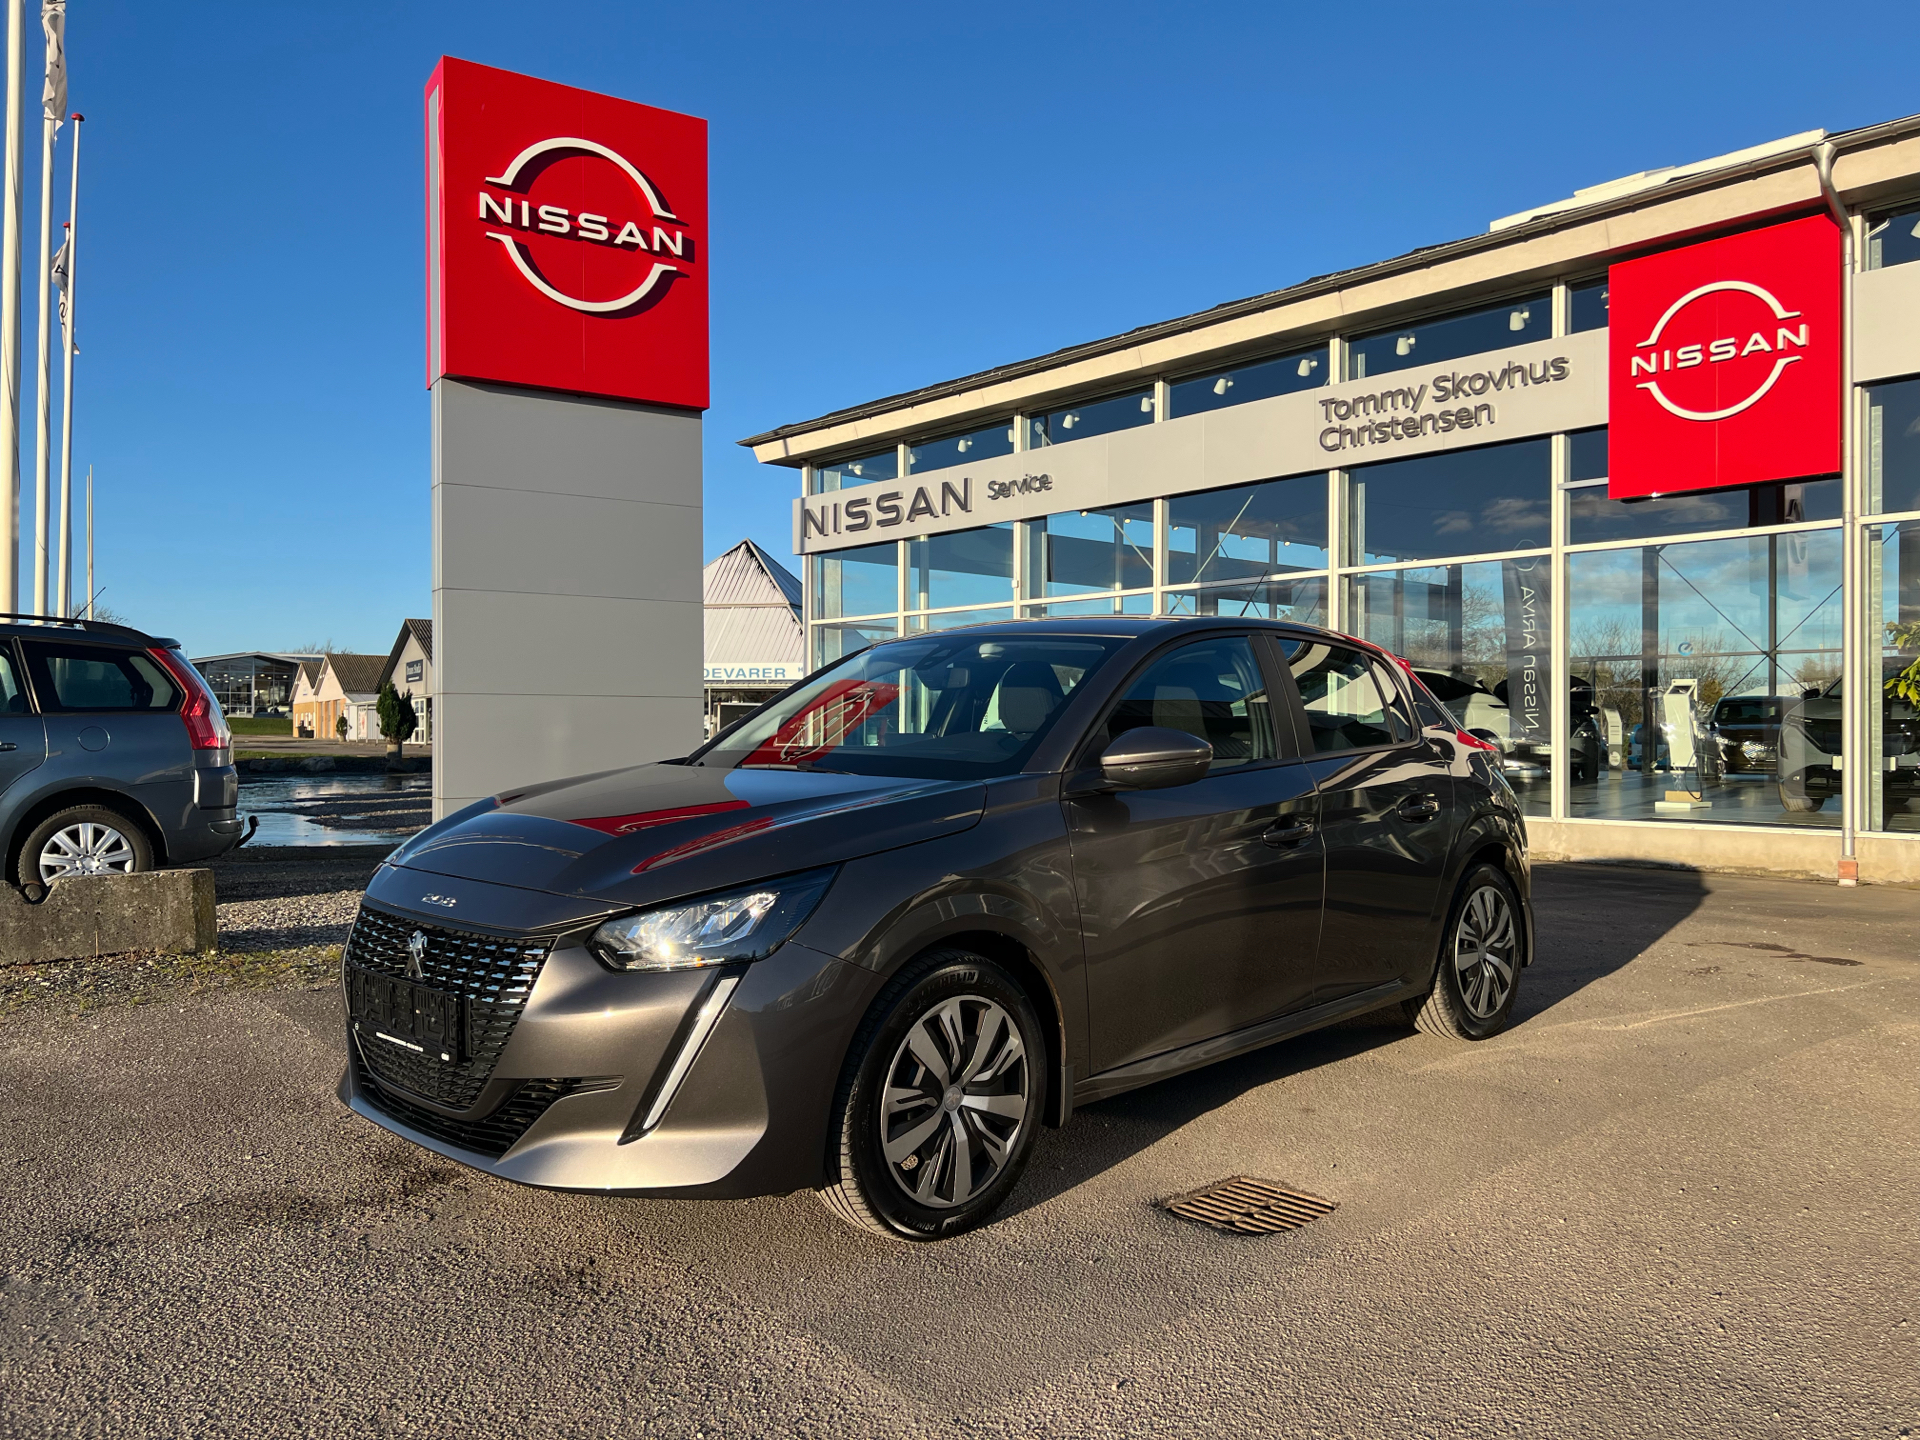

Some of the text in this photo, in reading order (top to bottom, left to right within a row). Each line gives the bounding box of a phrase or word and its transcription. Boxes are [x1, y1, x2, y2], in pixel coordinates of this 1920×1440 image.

[478, 191, 683, 257] NISSAN
[1630, 323, 1809, 377] NISSAN
[1318, 356, 1571, 423] Tommy Skovhus
[1319, 402, 1496, 452] Christensen
[802, 472, 1053, 539] NISSAN Service
[420, 892, 457, 908] 208
[903, 1213, 937, 1232] PRIMACY
